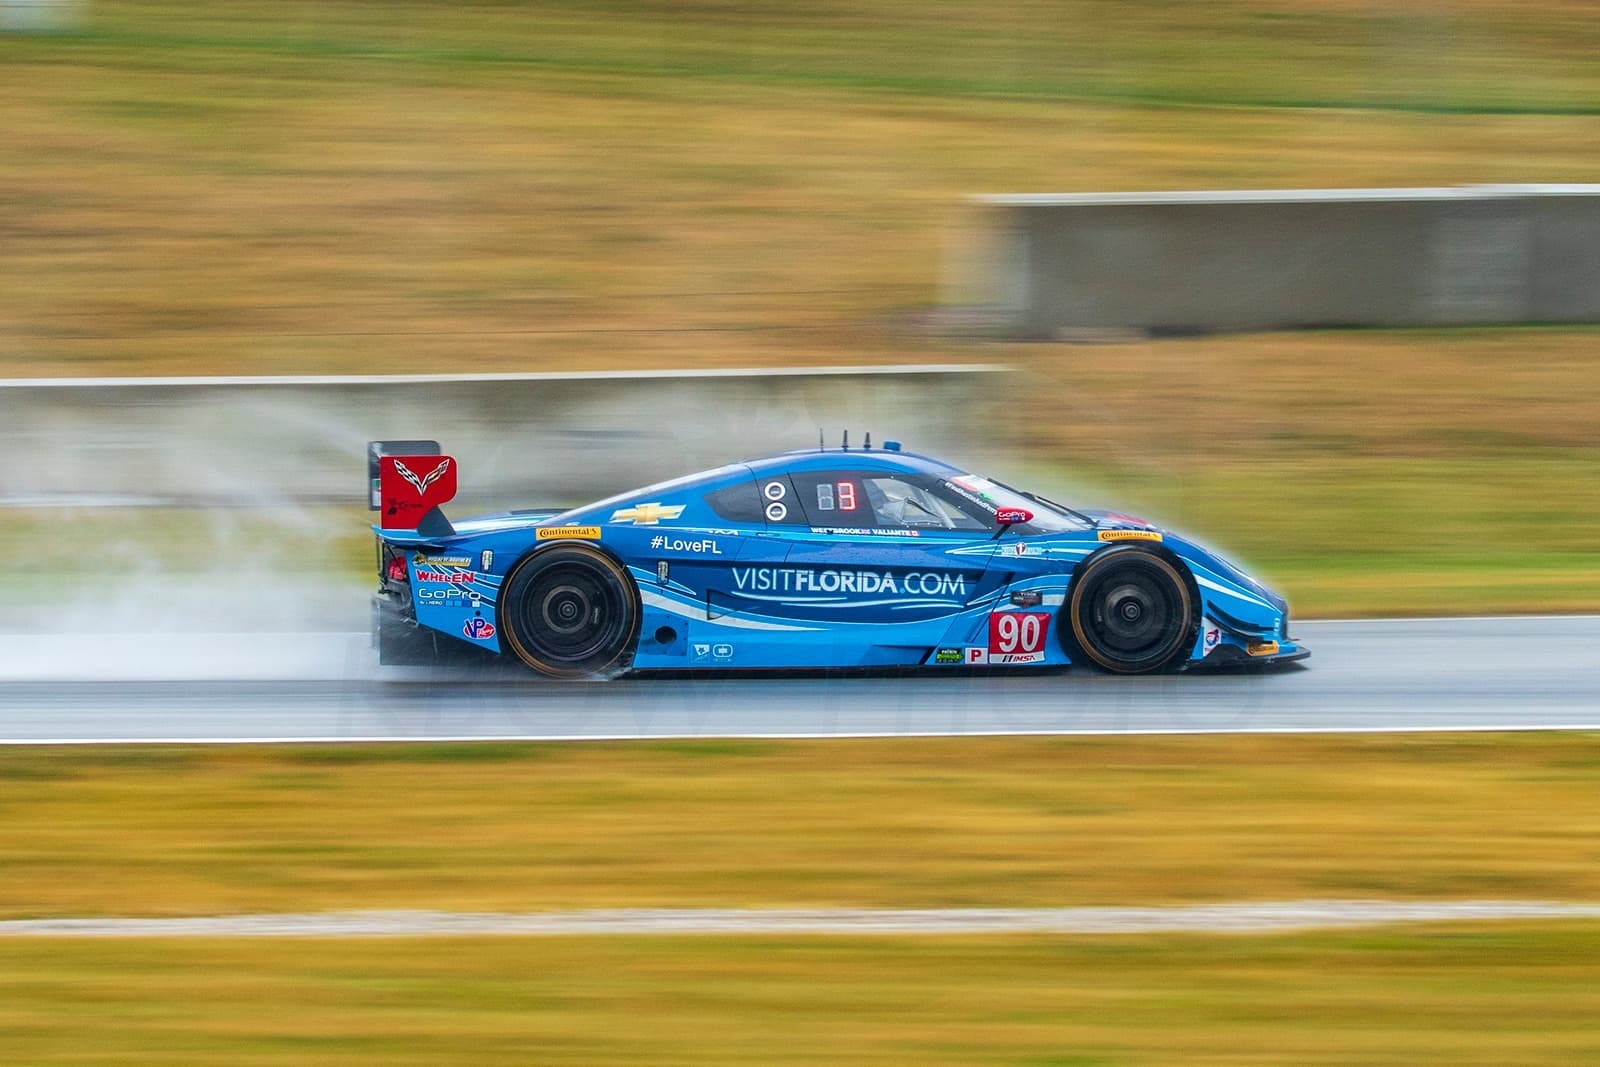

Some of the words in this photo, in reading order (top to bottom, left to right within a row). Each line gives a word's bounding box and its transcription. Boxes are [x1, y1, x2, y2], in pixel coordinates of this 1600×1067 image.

[539, 528, 590, 538] Continental
[1101, 531, 1150, 540] Continental
[650, 535, 722, 554] #LoveFL
[416, 569, 474, 584] WHELEN
[731, 567, 966, 596] VISITFLORIDA.COM
[418, 588, 481, 600] GoPro
[464, 618, 486, 638] VP
[998, 614, 1041, 653] 90
[970, 649, 982, 662] P
